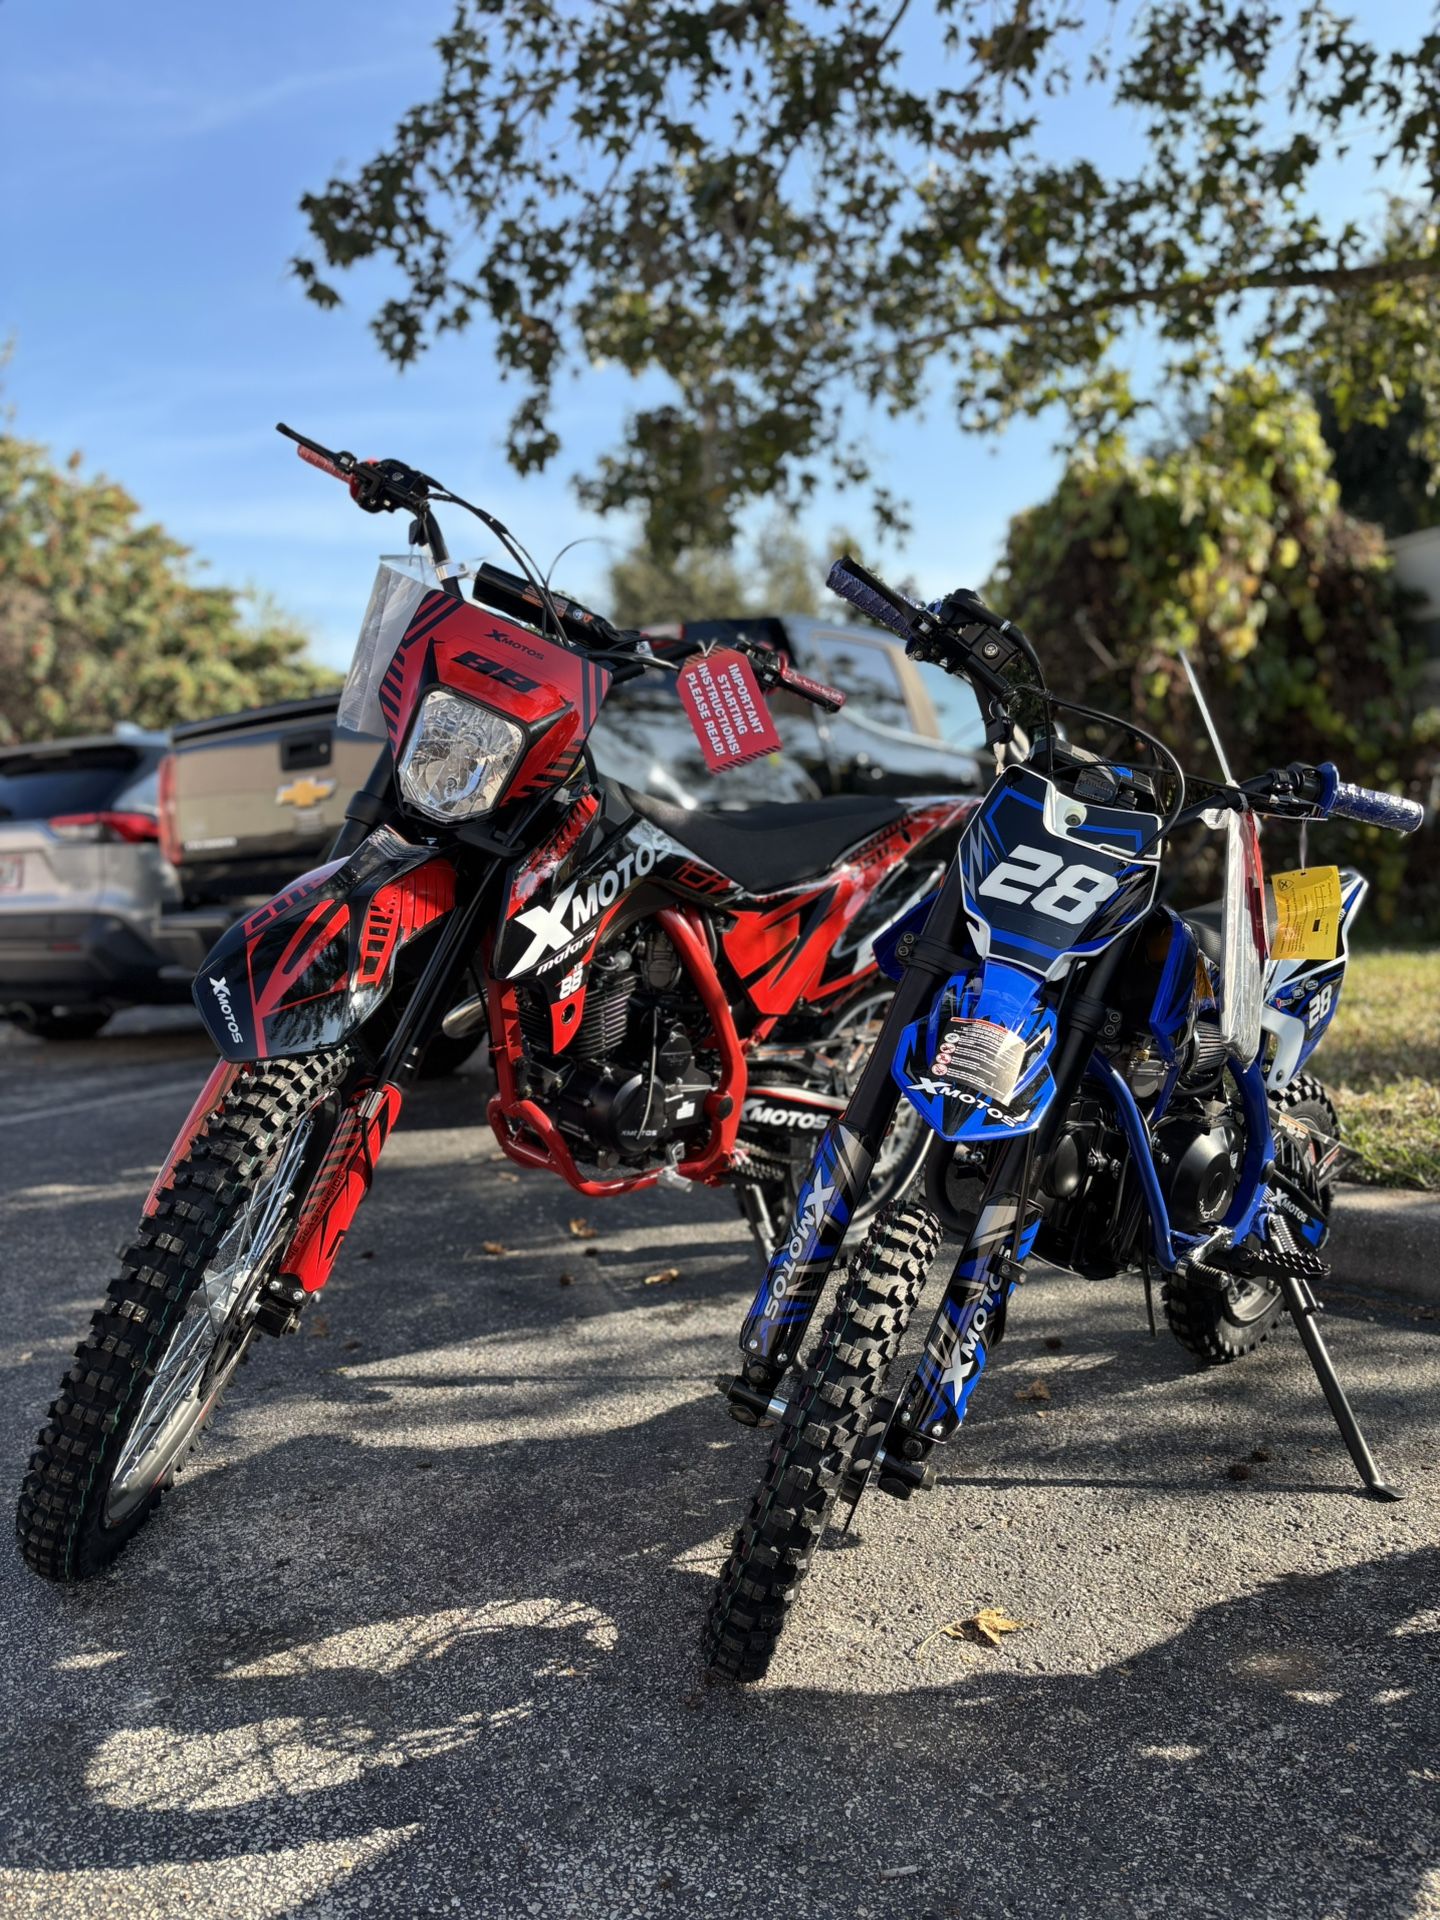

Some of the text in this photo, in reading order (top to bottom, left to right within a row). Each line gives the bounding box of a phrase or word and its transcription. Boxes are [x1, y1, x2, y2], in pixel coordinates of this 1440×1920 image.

[484, 628, 545, 660] XMOTOS
[685, 671, 727, 757] PLEASE READ!
[697, 662, 742, 756] INSTRUCTIONS!
[716, 673, 748, 735] STARTING
[728, 662, 765, 734] IMPORTANT
[505, 828, 673, 979] XMOTOS
[978, 844, 1119, 925] 28
[209, 976, 244, 1044] XMOTOS
[1308, 983, 1333, 1029] 28
[906, 1076, 1019, 1129] XMOTOS
[321, 1171, 347, 1208] INSIDE
[1269, 1187, 1309, 1223] XMOTOS
[763, 1166, 836, 1322] XMOTOS
